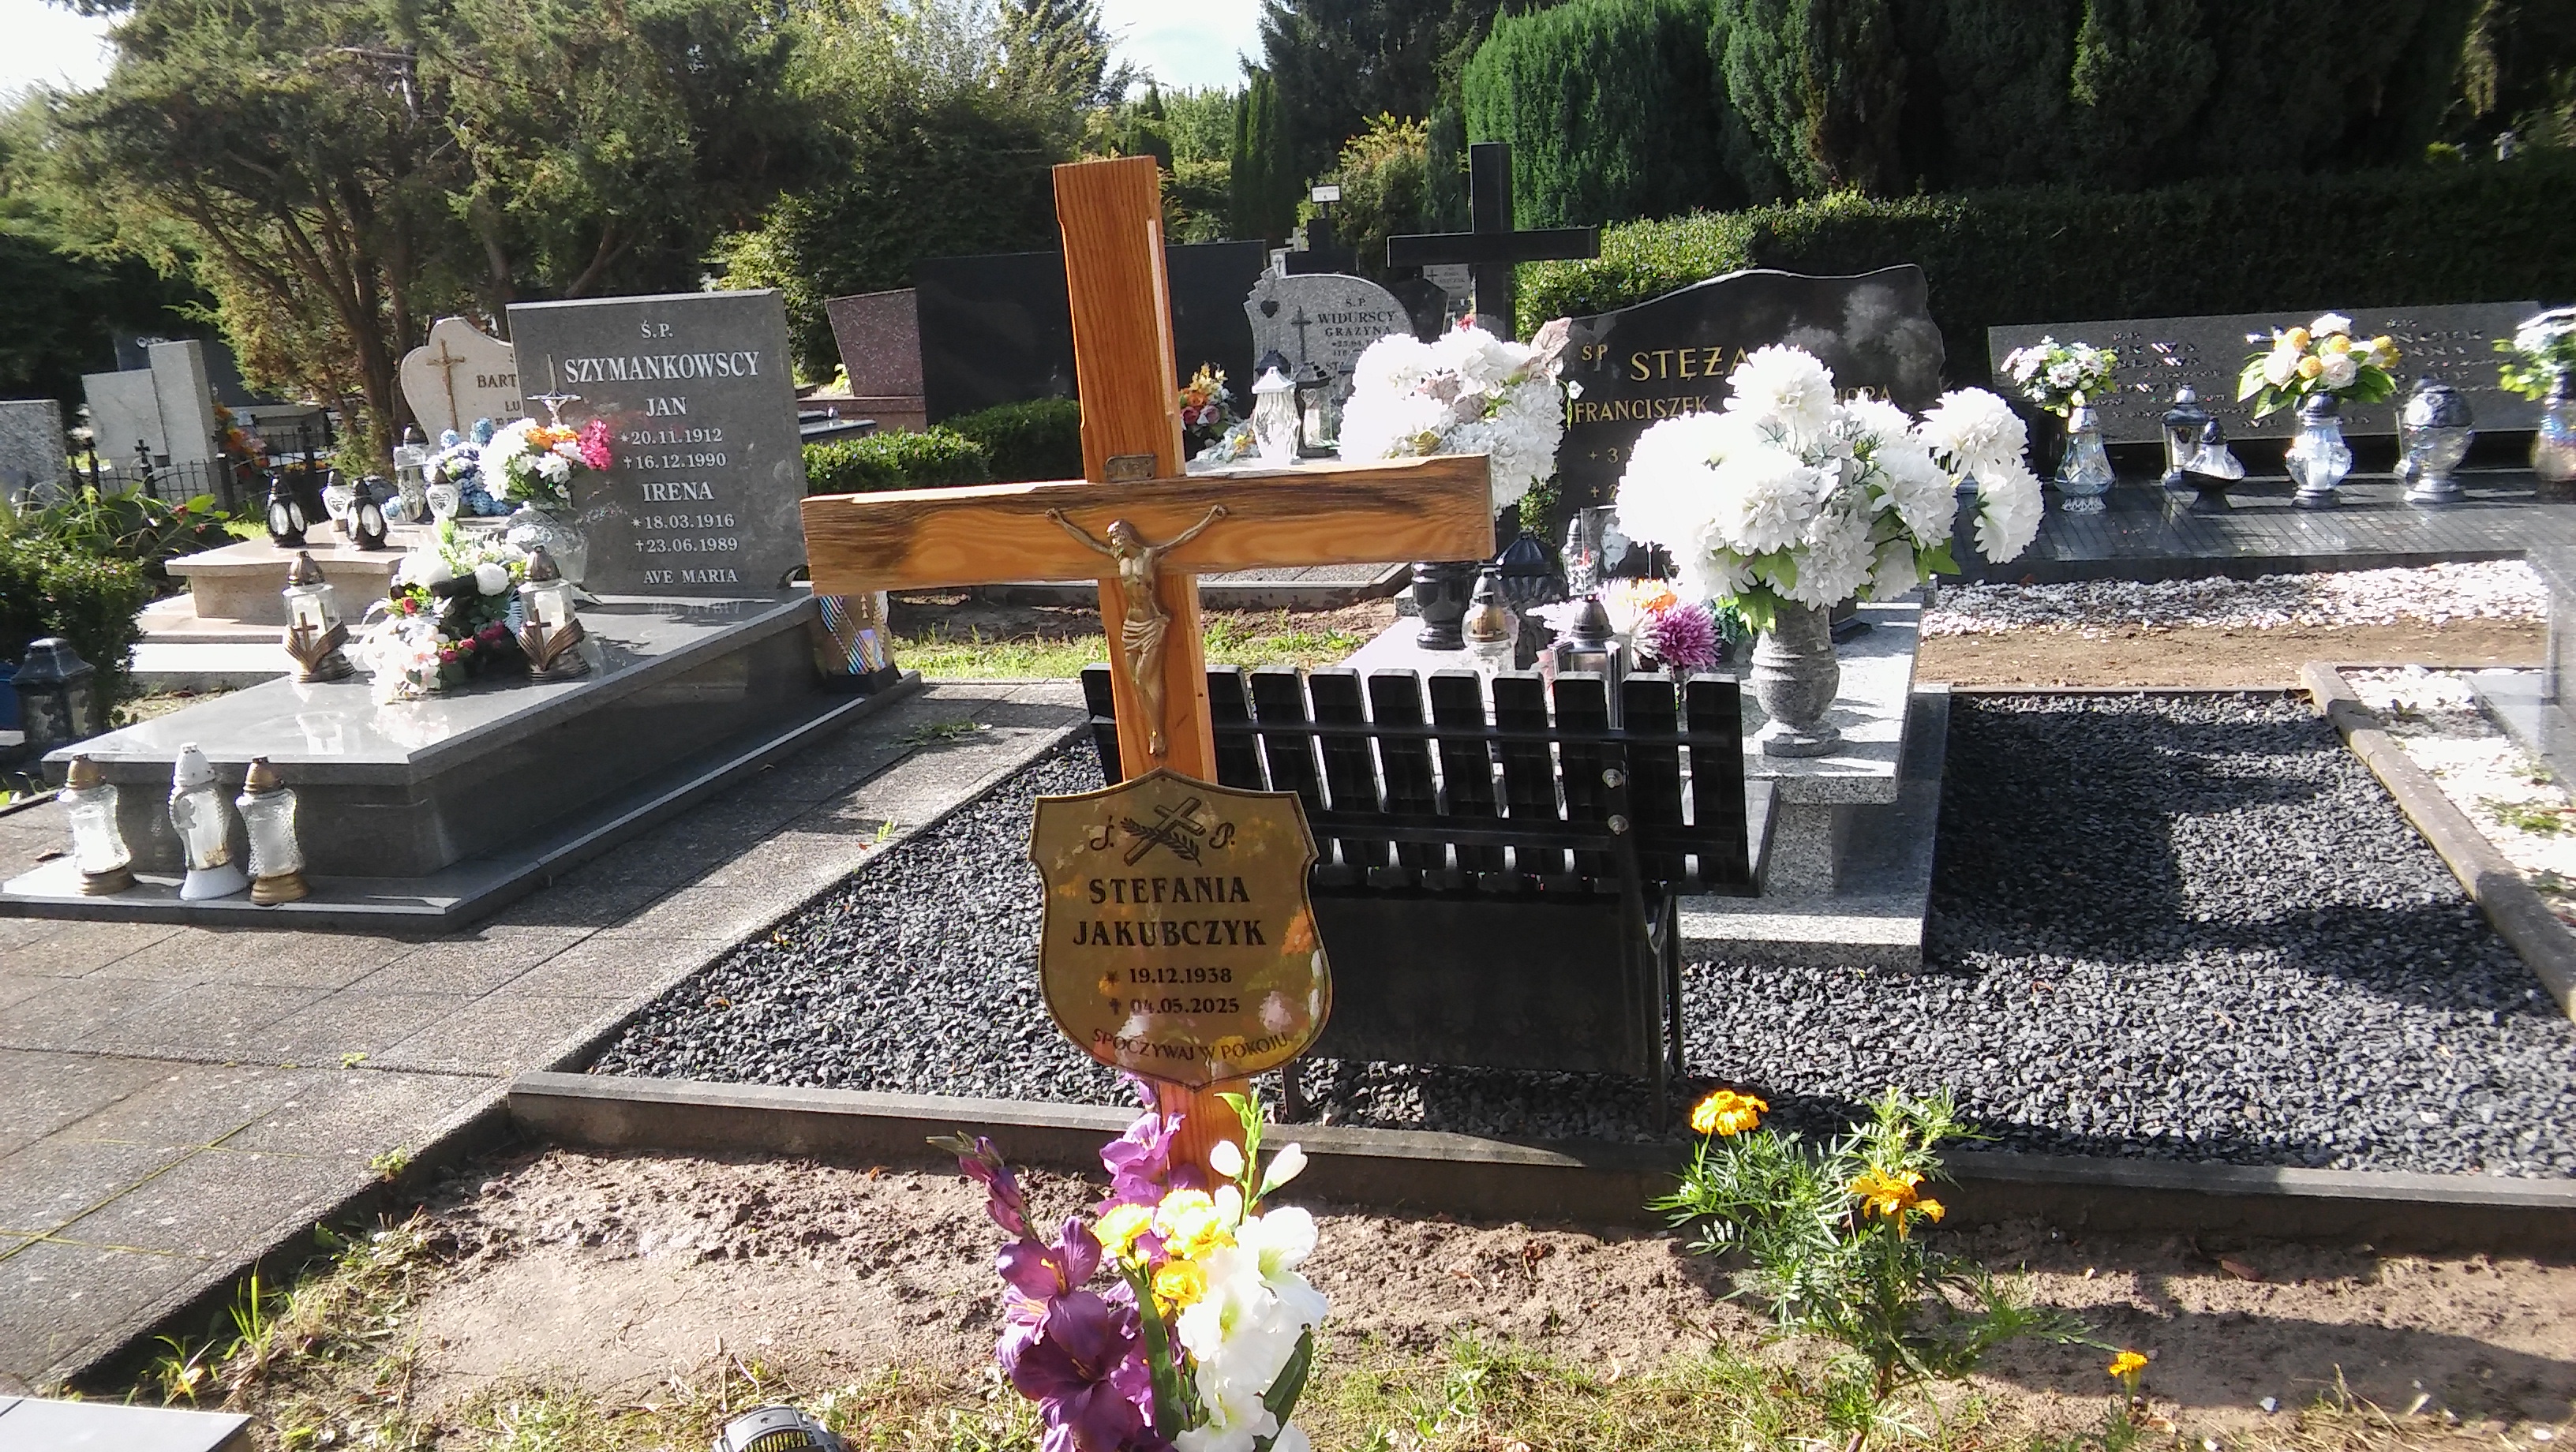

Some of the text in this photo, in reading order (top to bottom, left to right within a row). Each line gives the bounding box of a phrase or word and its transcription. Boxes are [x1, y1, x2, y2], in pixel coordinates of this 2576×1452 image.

[564, 351, 761, 384] SZYMANKOWSCY
[646, 396, 687, 417] JAN
[1574, 395, 1709, 424] FRANCISZEK
[631, 428, 723, 445] 20.11.1912
[635, 452, 727, 470] 16.12.1990
[642, 481, 715, 502] IRENA
[645, 513, 735, 530] 18.03.1916
[646, 537, 738, 553] 23.06.1989
[643, 568, 739, 585] AVE MARIA
[1088, 876, 1251, 904] STEFANIA
[1073, 919, 1267, 948] JAKUBCZYK
[1129, 967, 1233, 984] 19.12.1938
[1129, 997, 1240, 1014] 04.05.2025
[1091, 1027, 1289, 1061] SPOCZYWAJ W POKOJU
